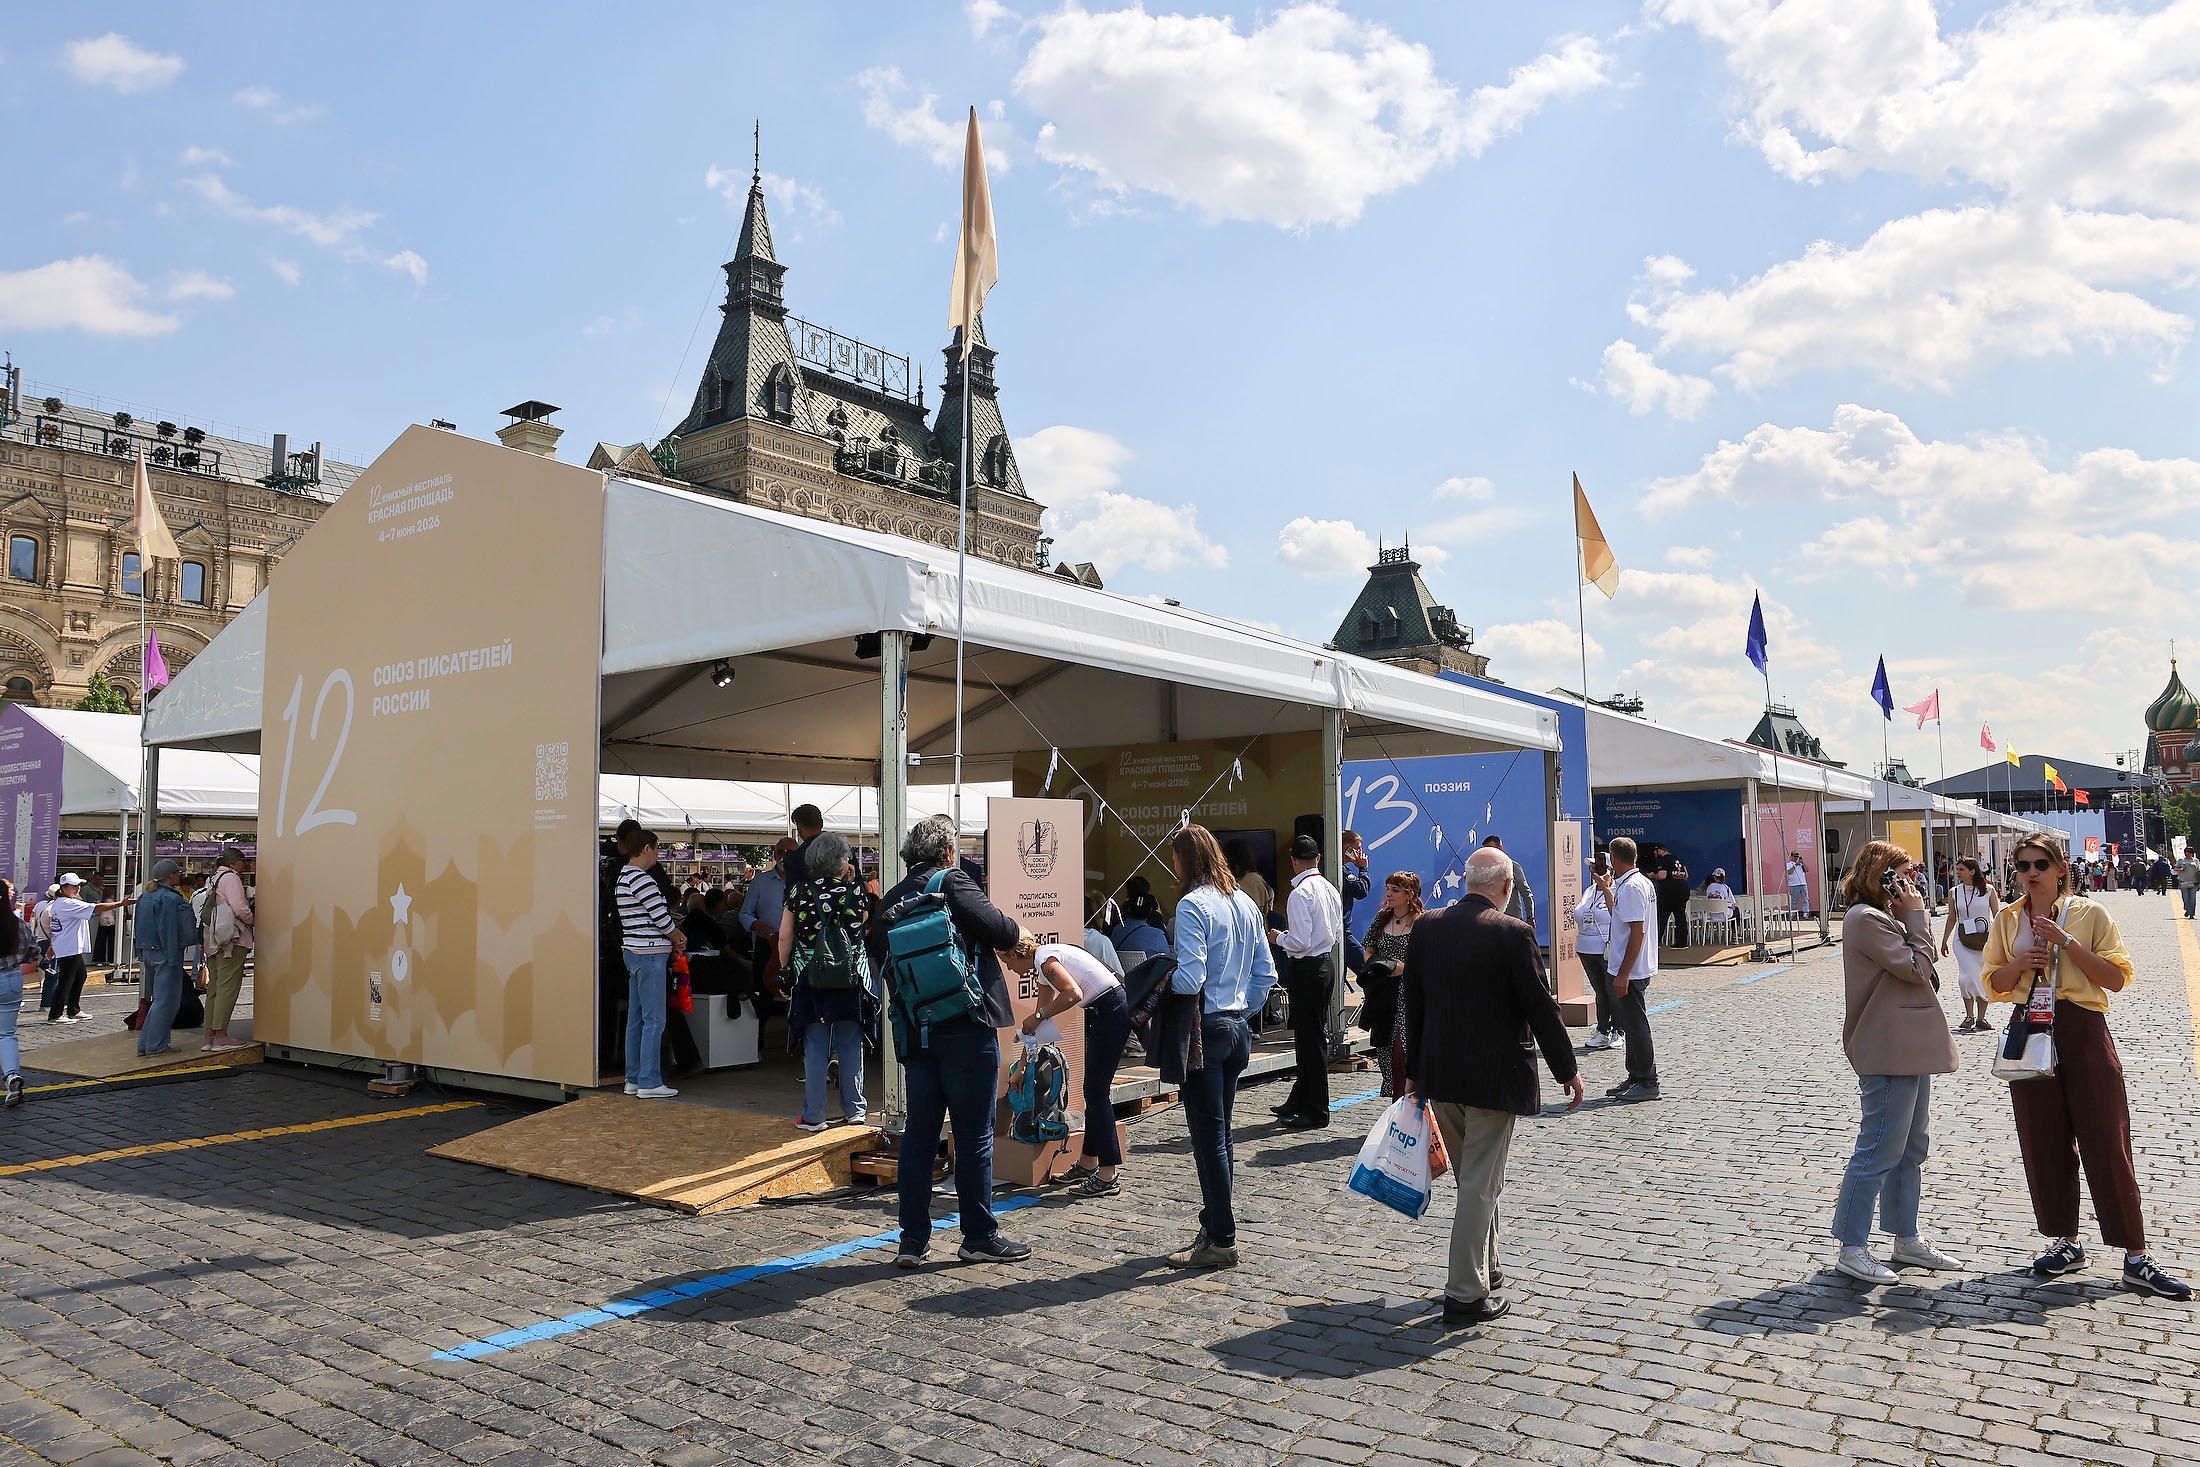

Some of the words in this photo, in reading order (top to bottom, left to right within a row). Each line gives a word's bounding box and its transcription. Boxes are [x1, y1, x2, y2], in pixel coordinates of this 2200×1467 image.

[811, 332, 878, 378] ГУМ
[369, 484, 382, 509] 12
[414, 473, 453, 493] ФЕСТИВАЛЬ
[368, 499, 406, 524] КРАСНАЯ
[407, 487, 455, 512] ПЛОЩАДЬ
[416, 515, 440, 533] 2026
[373, 660, 414, 687] СОЮЗ
[418, 637, 513, 680] ПИСАТЕЛЕЙ
[372, 689, 431, 717] РОССИИ
[276, 667, 357, 838] 12
[1119, 765, 1157, 776] КРАСНАЯ
[1158, 762, 1202, 774] ПЛОЩАДЬ
[1167, 779, 1190, 788] 2026
[1425, 781, 1471, 793] ПОЭЗИЯ
[1120, 807, 1160, 819] СОЮЗ
[1163, 798, 1248, 818] ПИАТЕЛЕЙ
[1344, 775, 1418, 851] 13
[1607, 827, 1644, 836] ПОЭЗИЯ
[1019, 892, 1057, 901] ПОДПИСАТЬСЯ
[1027, 910, 1055, 918] ЖУРНАЛЫ
[1389, 1121, 1417, 1149] frap
[2062, 1249, 2075, 1263] N
[2139, 1266, 2155, 1281] N
